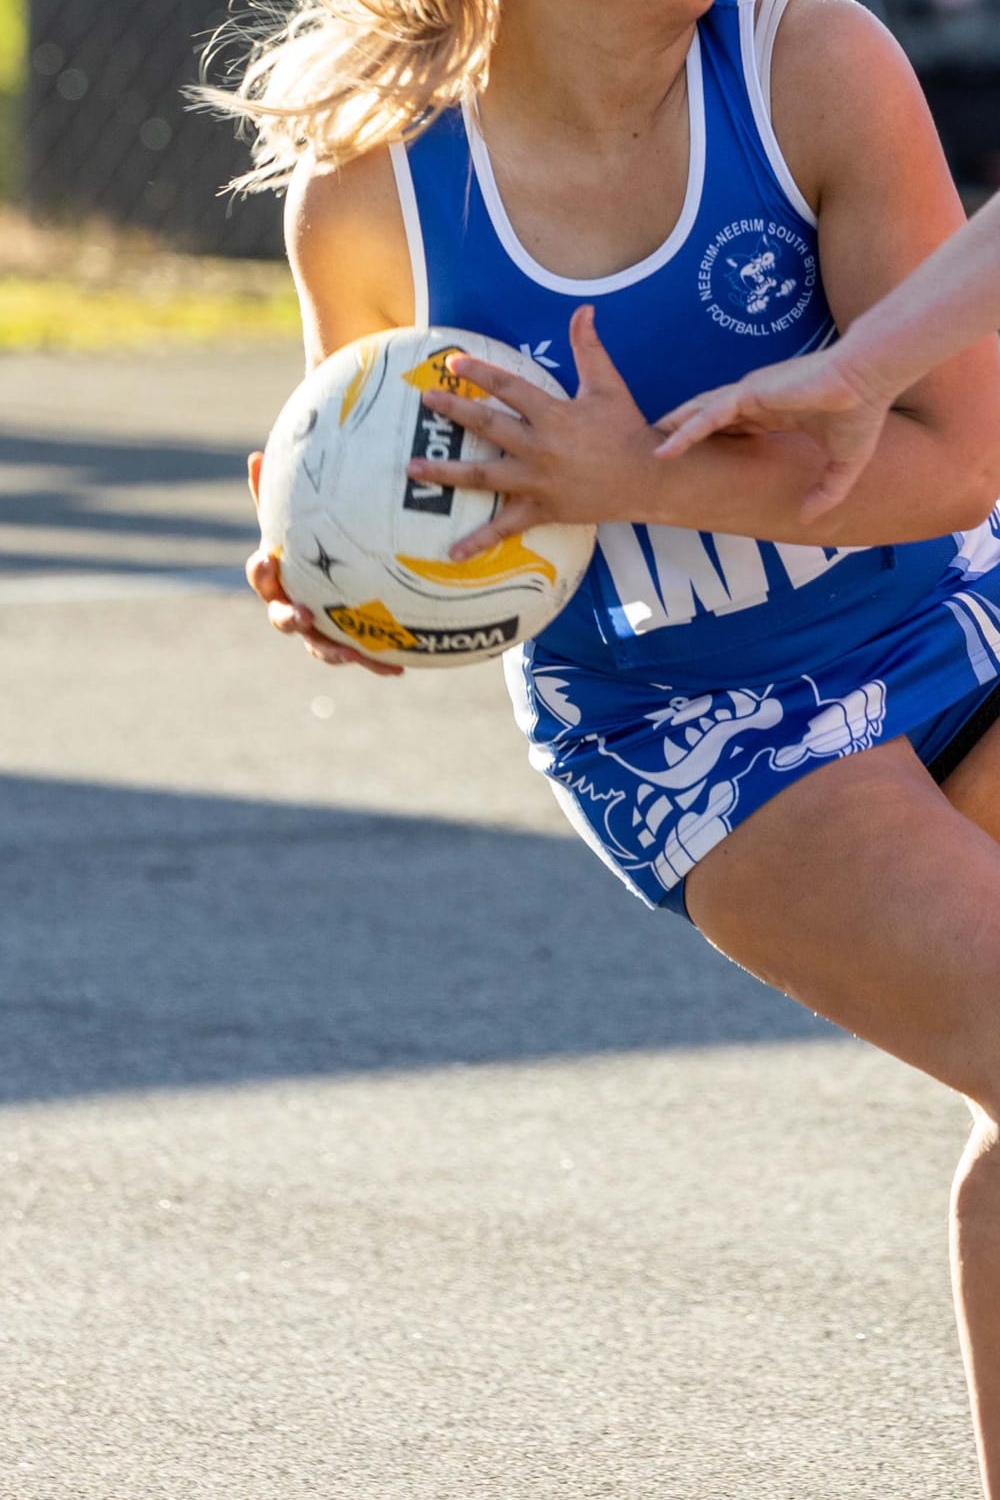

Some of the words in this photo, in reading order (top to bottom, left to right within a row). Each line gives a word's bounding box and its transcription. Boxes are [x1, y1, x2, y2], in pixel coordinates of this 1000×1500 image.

[767, 222, 809, 255] SOUTH
[706, 303, 770, 336] FOOTBALL
[770, 289, 814, 333] NETBALL
[804, 255, 816, 288] CLUB
